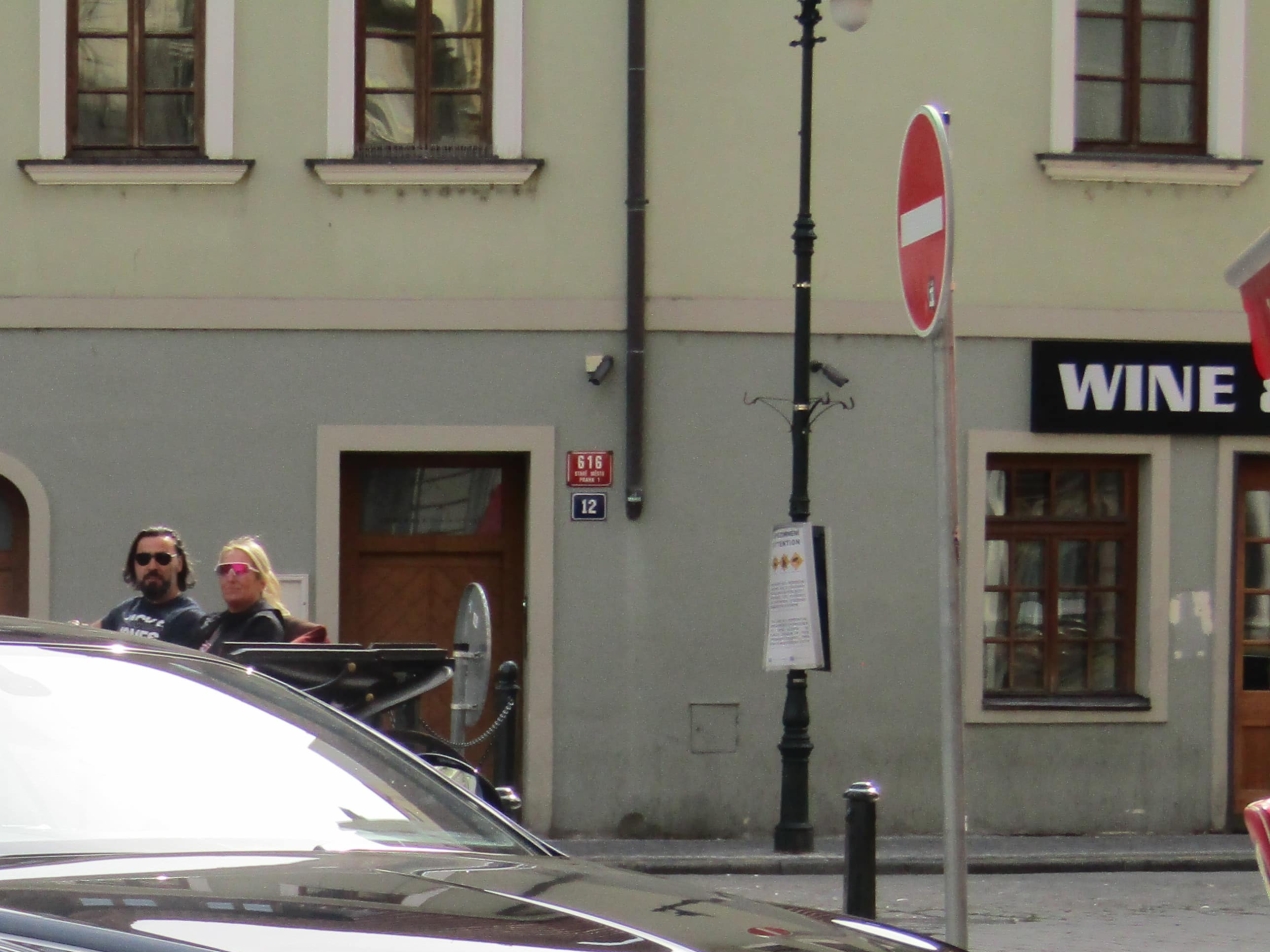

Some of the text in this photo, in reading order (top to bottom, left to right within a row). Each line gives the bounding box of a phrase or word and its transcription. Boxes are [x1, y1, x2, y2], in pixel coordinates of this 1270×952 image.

[1058, 364, 1236, 413] WINE
[578, 455, 602, 469] 616
[581, 499, 597, 514] 12
